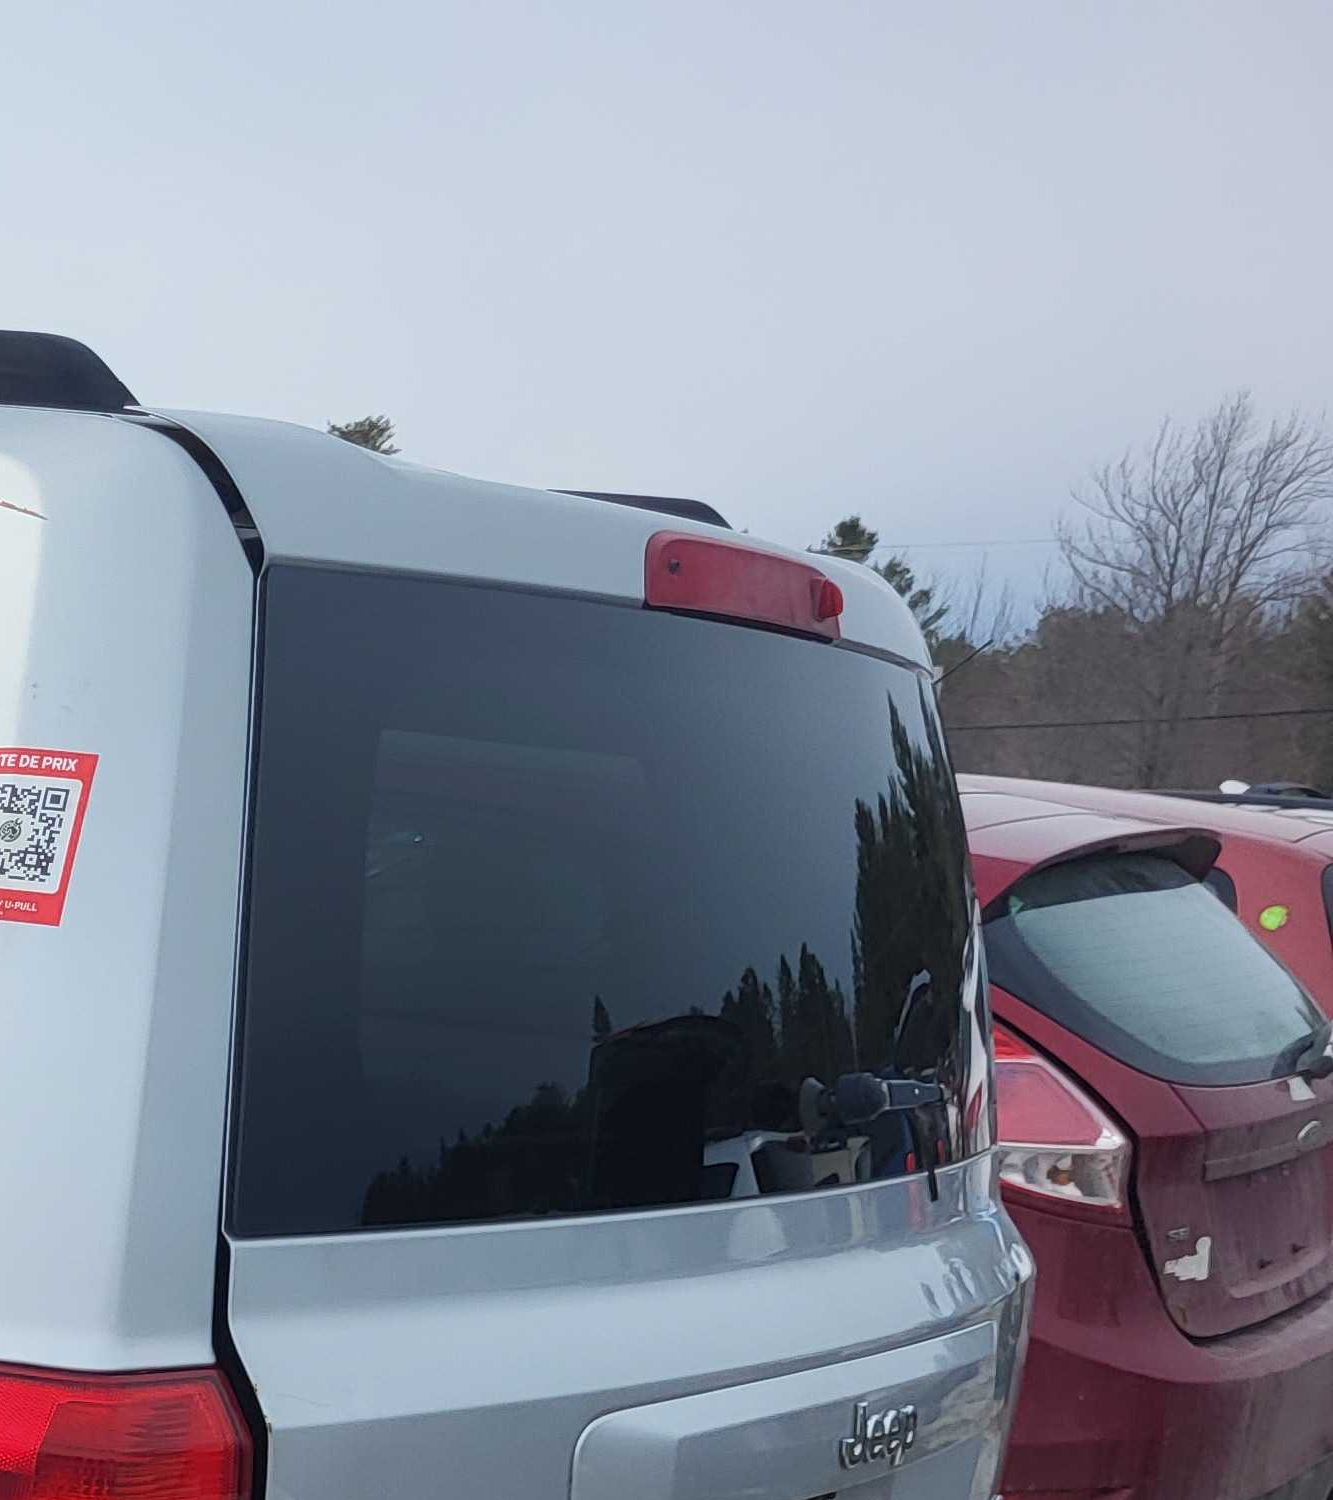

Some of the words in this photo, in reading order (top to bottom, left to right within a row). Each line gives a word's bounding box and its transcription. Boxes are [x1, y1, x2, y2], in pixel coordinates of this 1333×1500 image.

[18, 755, 40, 769] DE
[41, 756, 79, 772] PRIX
[839, 1401, 917, 1469] Jeep
